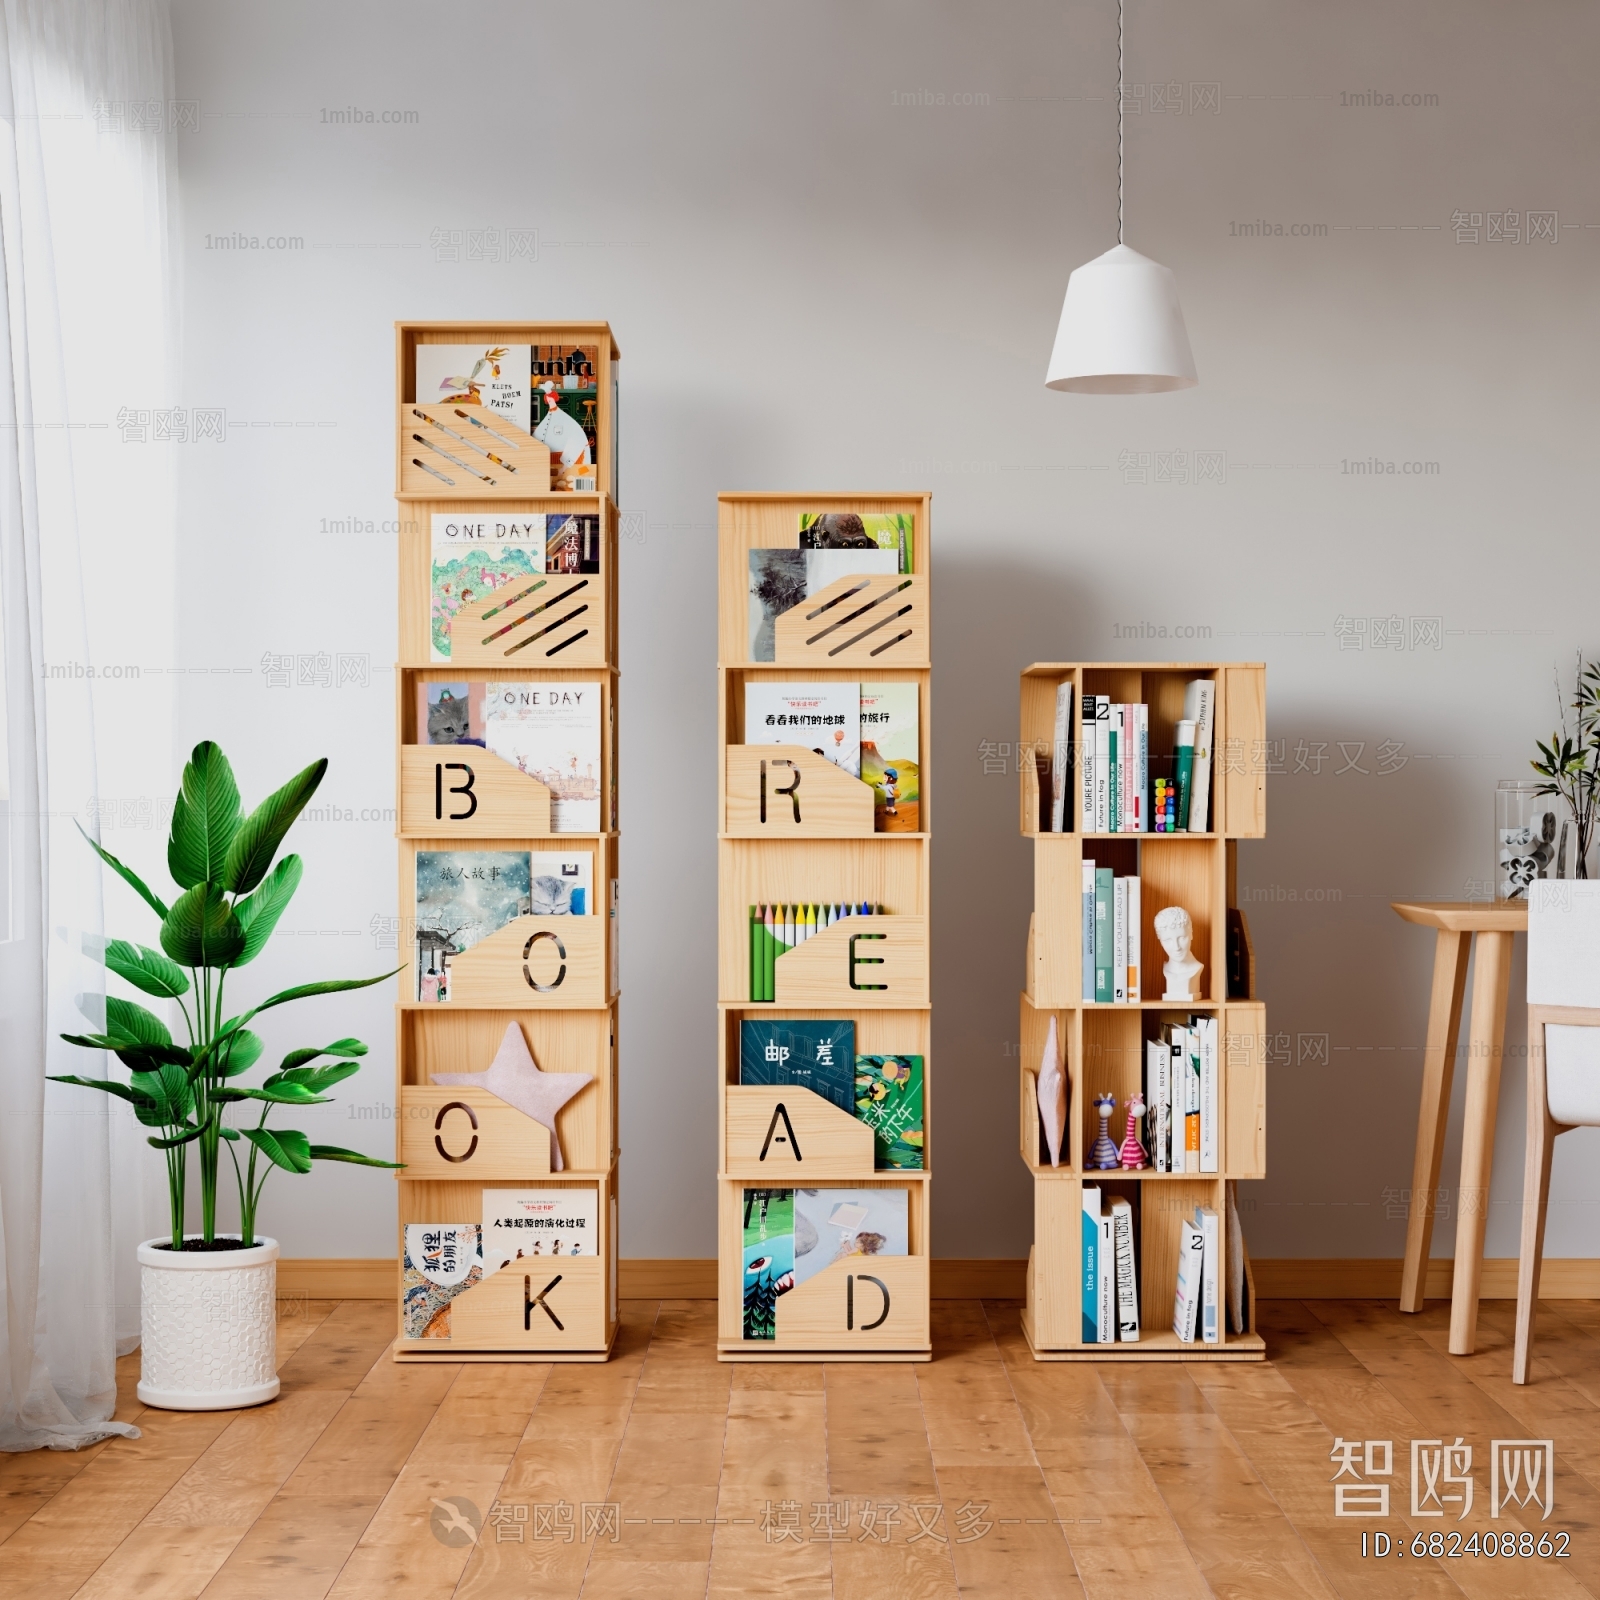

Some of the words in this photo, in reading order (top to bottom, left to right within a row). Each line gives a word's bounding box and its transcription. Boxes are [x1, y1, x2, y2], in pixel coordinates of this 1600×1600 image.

[445, 523, 485, 539] ONE
[495, 522, 533, 538] DAY
[504, 692, 540, 705] ONE
[549, 692, 584, 705] DAY
[1096, 703, 1109, 720] 2
[765, 714, 846, 725] 看看我们的地球
[1117, 711, 1124, 727] 1
[1084, 755, 1092, 787] PICTURE
[436, 763, 478, 820] B
[760, 759, 802, 824] R
[1084, 788, 1092, 812] YOURE
[1098, 794, 1104, 802] in
[439, 866, 501, 881] 旅人故事
[1117, 884, 1123, 895] UP
[523, 931, 566, 992] O
[849, 934, 888, 990] E
[765, 1038, 834, 1066] 邮差
[435, 1102, 478, 1163] O
[759, 1103, 802, 1161] A
[493, 1218, 586, 1229] 人类起源的演化过程
[1103, 1222, 1109, 1239] 1
[1114, 1213, 1130, 1252] NUMBER
[442, 1230, 457, 1273] 的朋友
[1191, 1235, 1203, 1250] 2
[1116, 1253, 1133, 1289] MAGICK
[525, 1275, 565, 1331] K
[847, 1275, 890, 1331] D
[1119, 1291, 1134, 1307] THE
